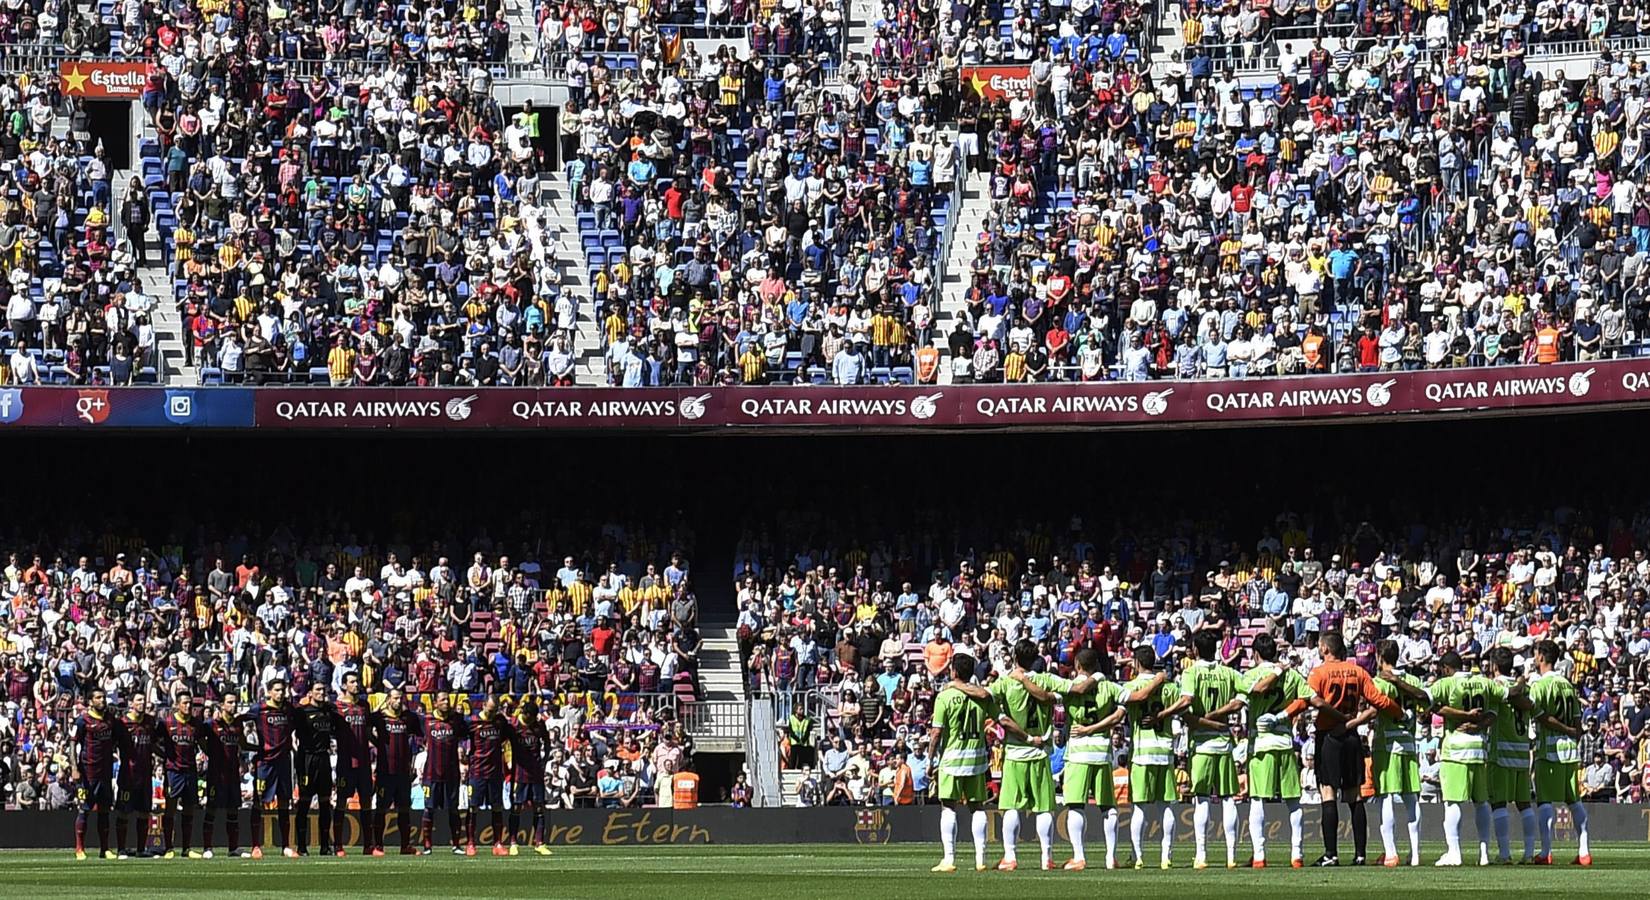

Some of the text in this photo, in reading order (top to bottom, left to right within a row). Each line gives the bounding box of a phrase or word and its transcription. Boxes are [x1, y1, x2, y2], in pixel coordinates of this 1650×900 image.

[91, 69, 145, 86] Estrella
[990, 74, 1031, 91] Estrel
[106, 85, 131, 93] Damm
[1005, 89, 1029, 98] Dam
[1425, 377, 1565, 402] QATAR AIRWAYS
[741, 399, 906, 417] QATAR AIRWAYS
[976, 395, 1138, 416] QATAR AIRWAYS
[1206, 388, 1361, 412] QATAR AIRWAYS
[276, 401, 441, 420] QATAR AIRWAYS
[512, 400, 676, 420] QATAR AIRWAYS
[431, 729, 454, 738] QATAR
[603, 812, 710, 844] Etern
